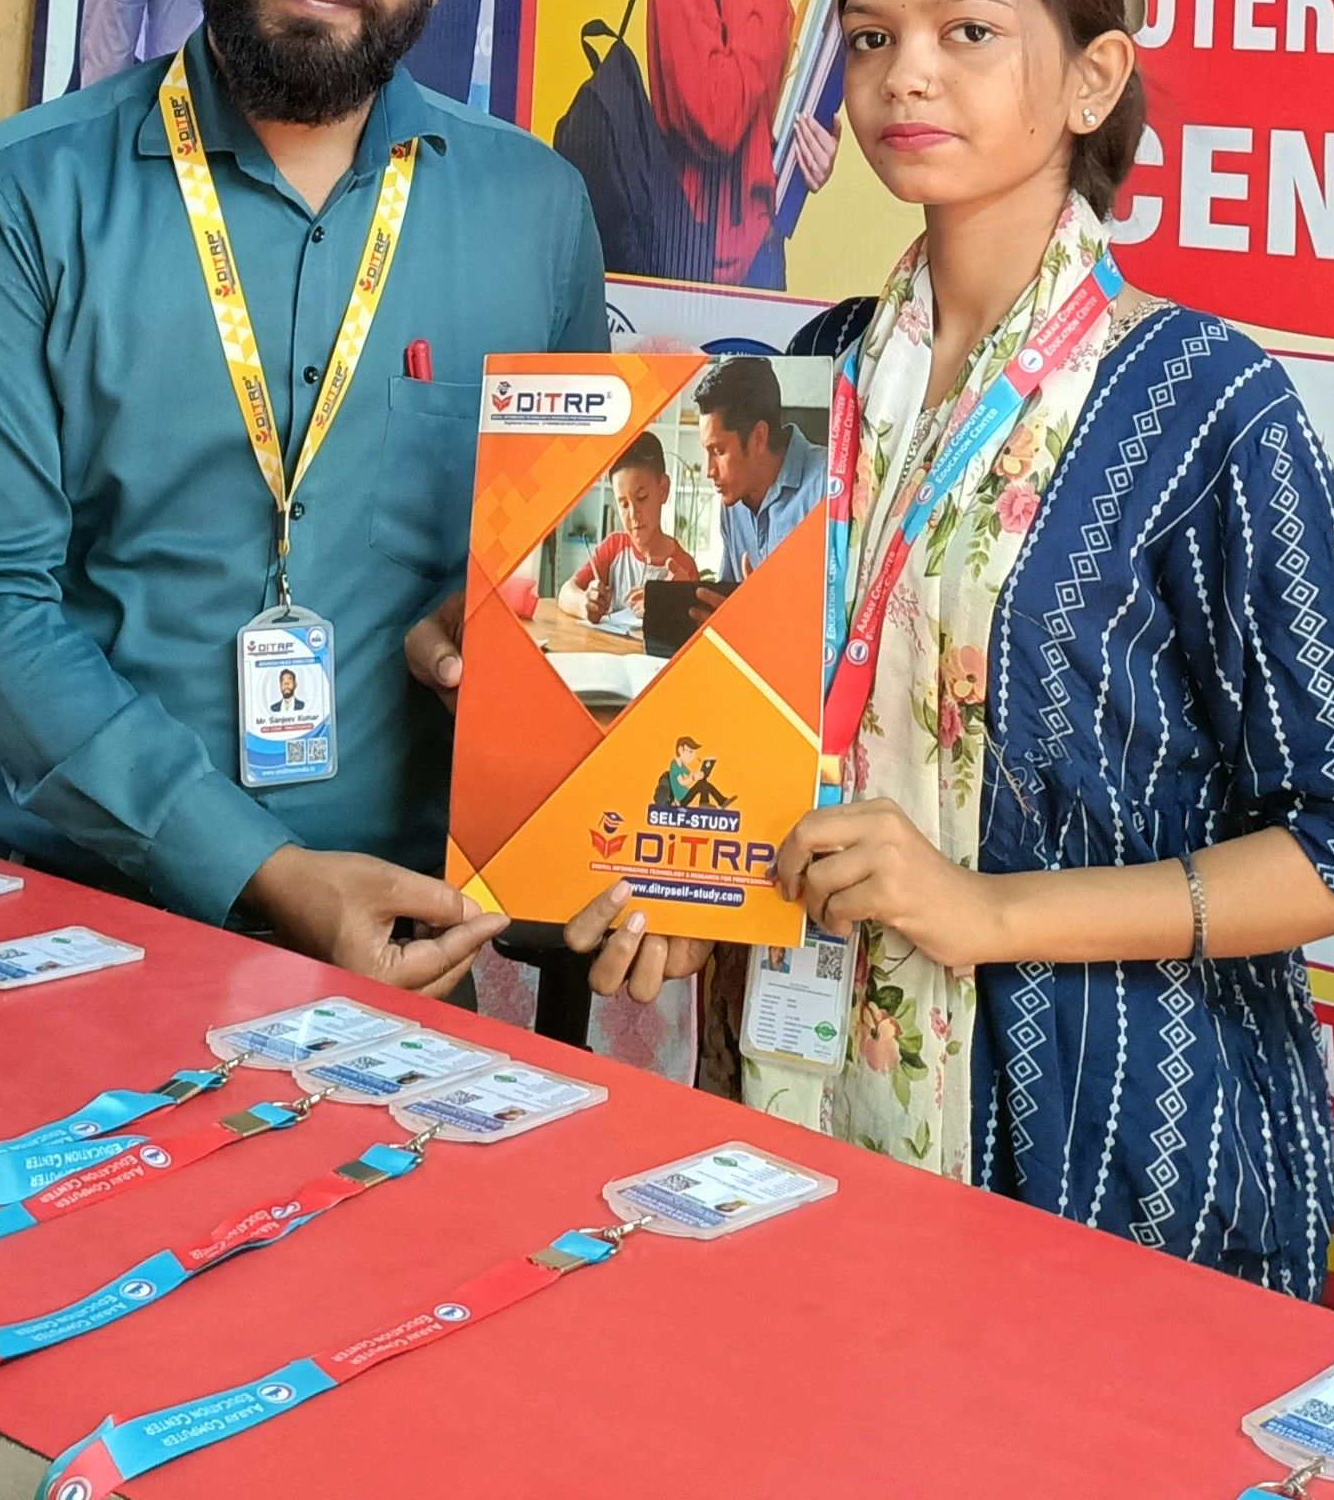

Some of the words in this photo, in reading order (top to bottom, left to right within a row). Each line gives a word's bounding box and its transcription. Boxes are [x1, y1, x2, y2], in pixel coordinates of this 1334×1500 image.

[649, 810, 739, 832] SELF-STUDY
[143, 1412, 192, 1436] CENTER
[161, 1417, 227, 1448] COMPUTER
